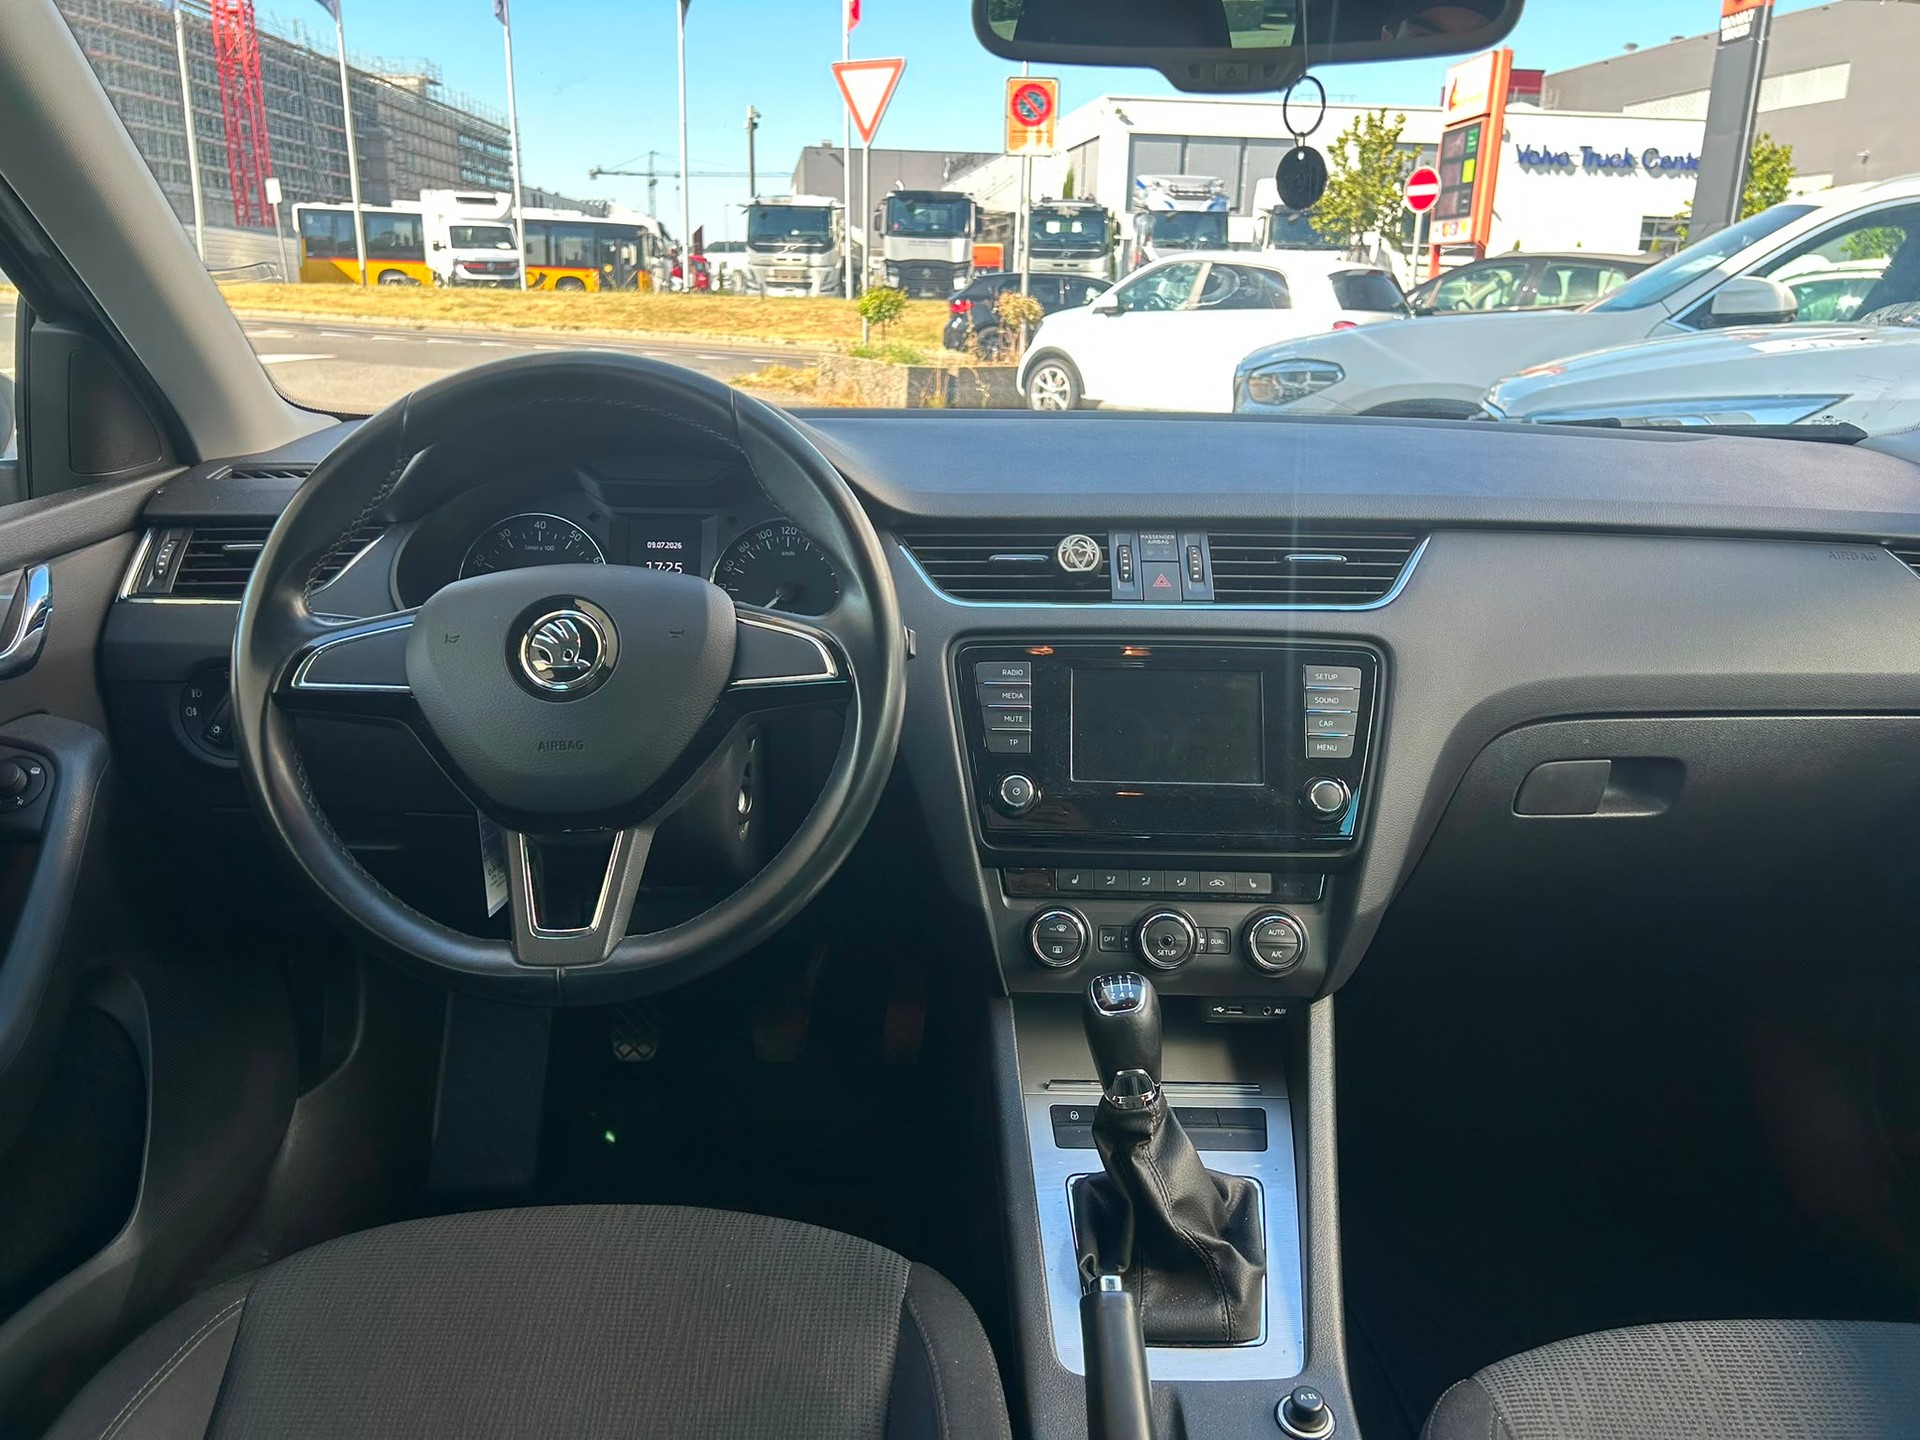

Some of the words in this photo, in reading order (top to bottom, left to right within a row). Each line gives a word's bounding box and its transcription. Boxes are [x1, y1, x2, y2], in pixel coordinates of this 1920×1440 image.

[1516, 144, 1571, 167] Volvo
[1579, 146, 1634, 168] Truck
[533, 521, 547, 530] 40
[781, 526, 797, 536] 120
[498, 528, 511, 540] 30
[569, 530, 582, 542] 50
[756, 528, 773, 541] 100
[646, 541, 683, 550] 09.07.2026
[737, 541, 750, 553] 80
[473, 554, 485, 567] 20
[1828, 551, 1878, 561] AIRBAG
[646, 561, 683, 574] 17:25
[723, 560, 735, 572] 60
[1004, 715, 1023, 723] MUTE
[538, 740, 584, 751] AIRBAG
[1157, 949, 1177, 957] SETUP
[1271, 950, 1283, 958] A/C
